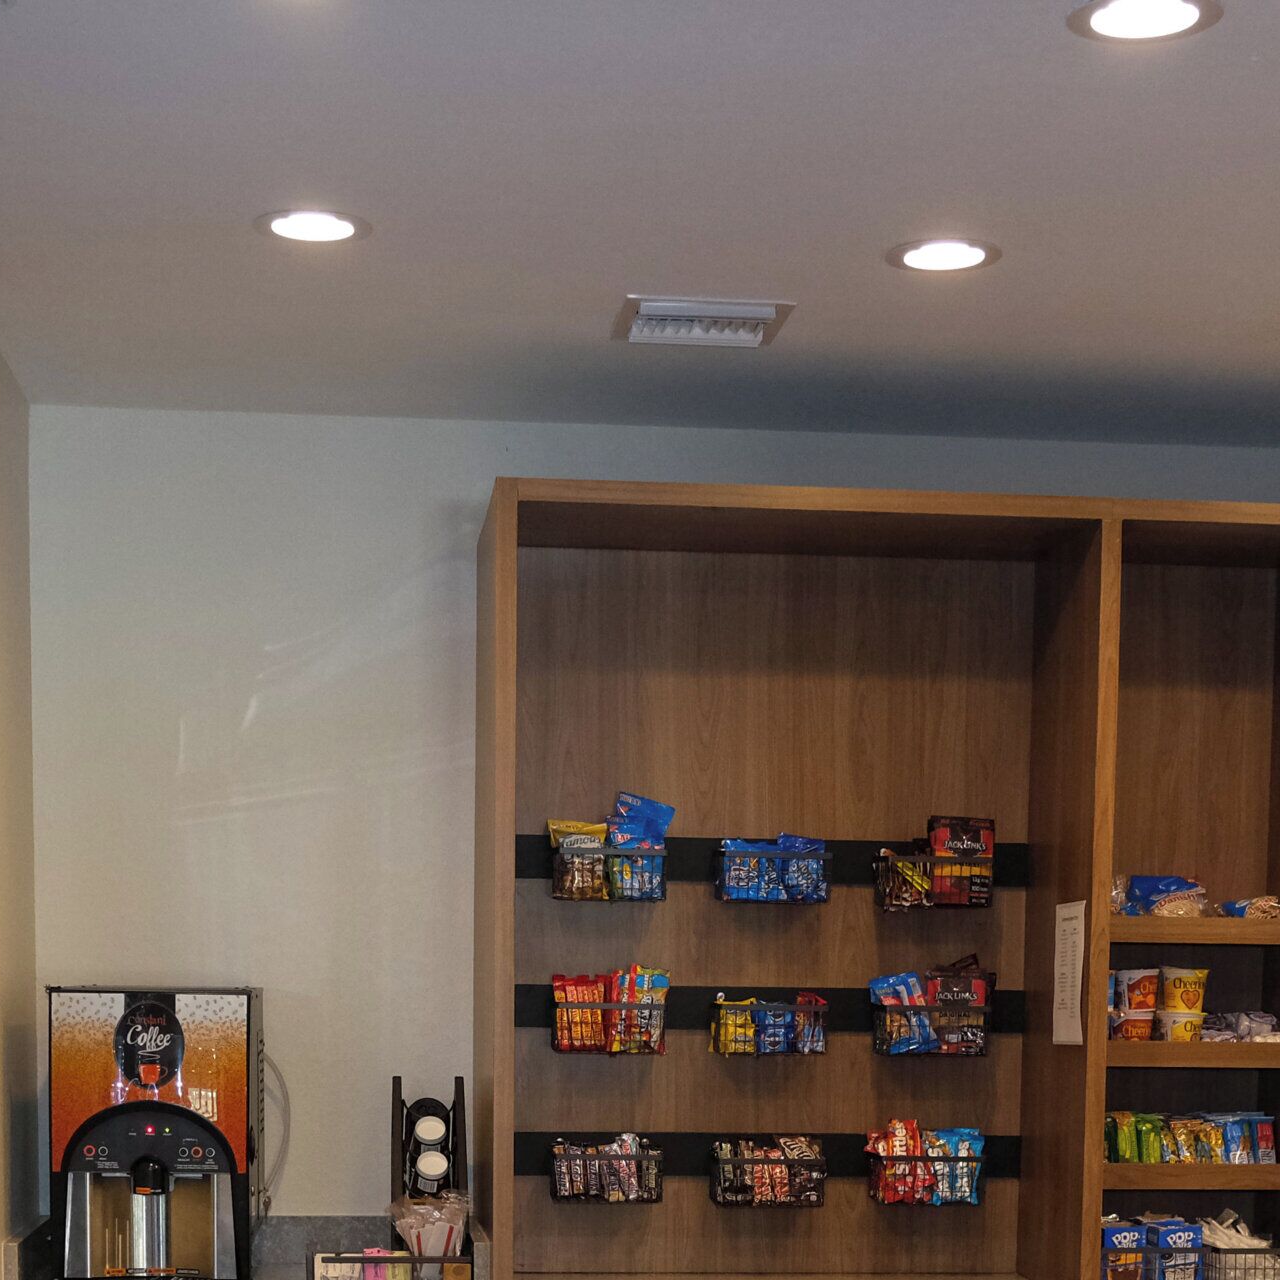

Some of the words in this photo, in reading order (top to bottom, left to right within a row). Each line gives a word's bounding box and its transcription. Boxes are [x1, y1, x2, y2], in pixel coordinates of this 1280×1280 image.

[943, 840, 963, 849] JACK
[1158, 892, 1196, 908] Danish
[935, 992, 953, 1000] JACK
[126, 1025, 172, 1051] Coffee
